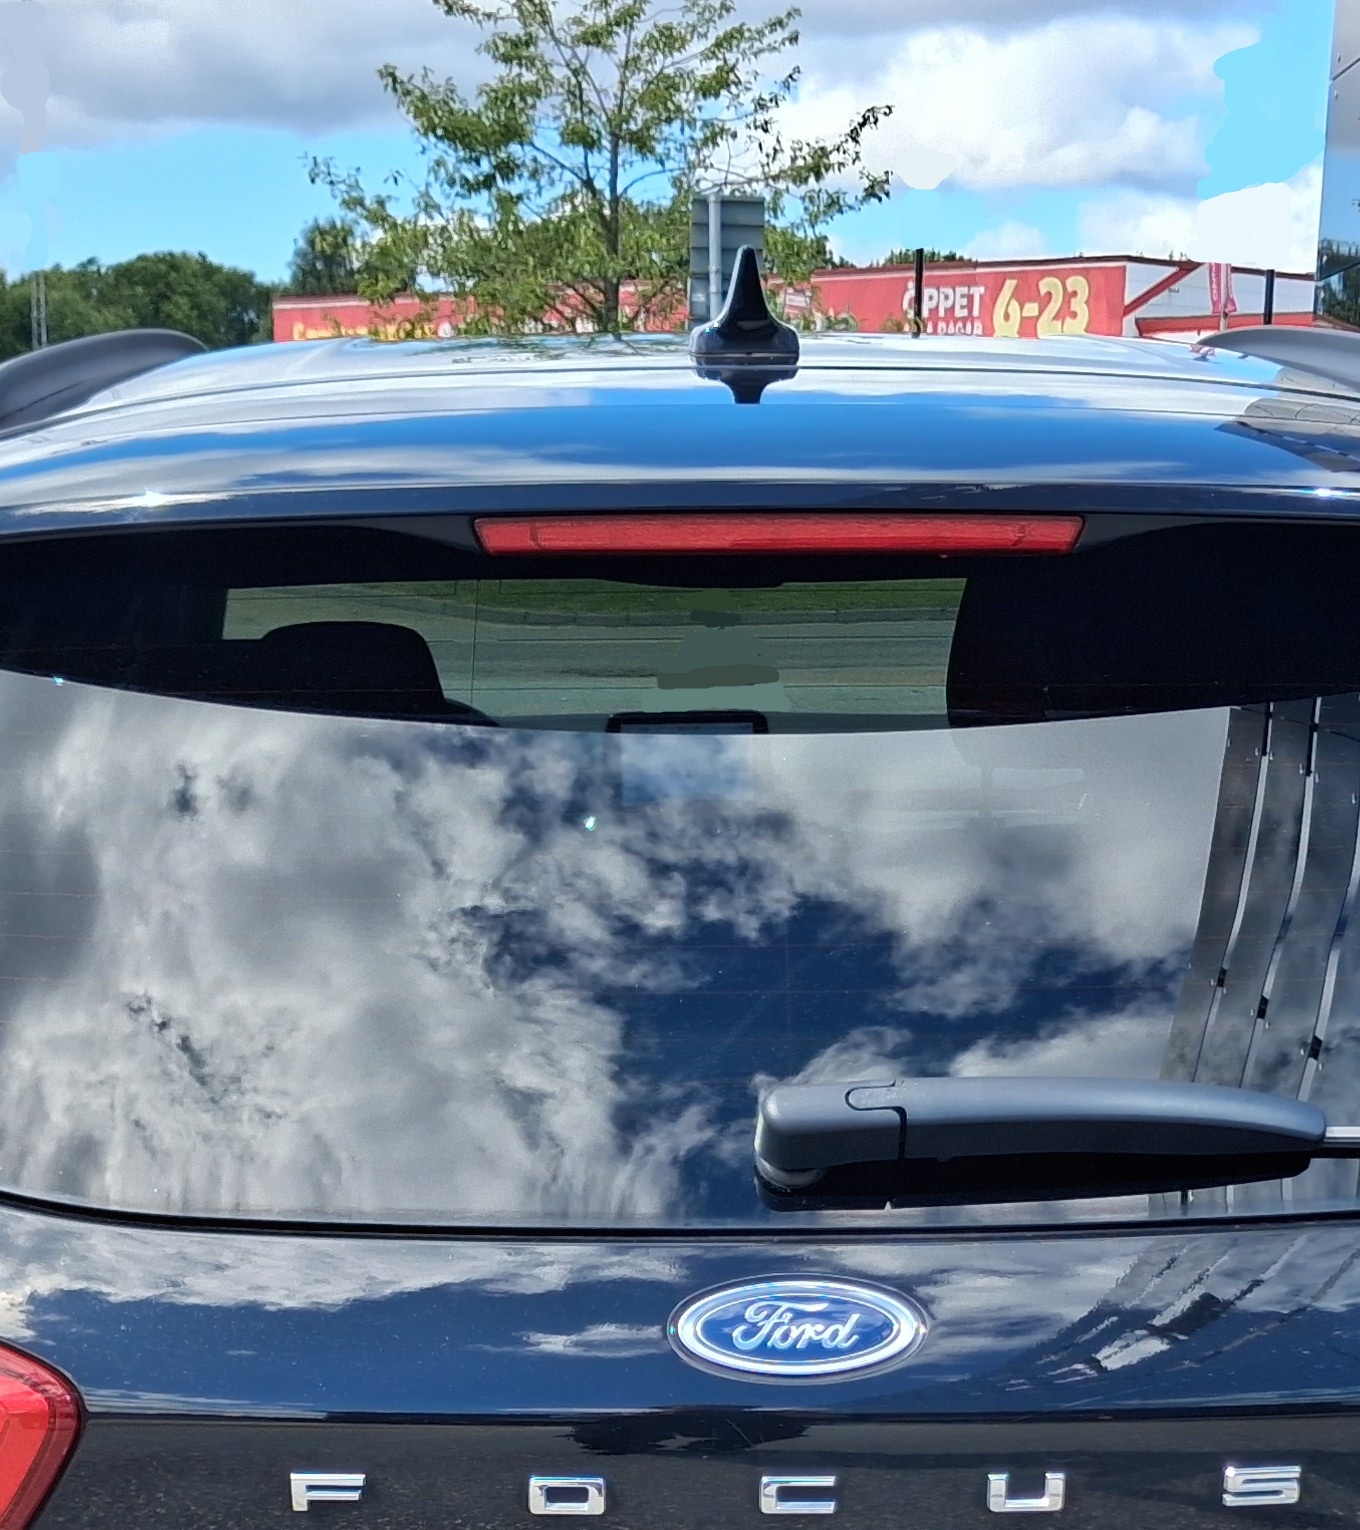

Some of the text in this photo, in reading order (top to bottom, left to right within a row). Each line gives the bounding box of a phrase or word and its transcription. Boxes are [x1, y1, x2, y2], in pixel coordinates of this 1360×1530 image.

[902, 281, 985, 318] ÖPPET
[993, 276, 1089, 338] 6-23
[731, 1300, 861, 1350] Ford
[289, 1465, 1304, 1516] FOCUS
